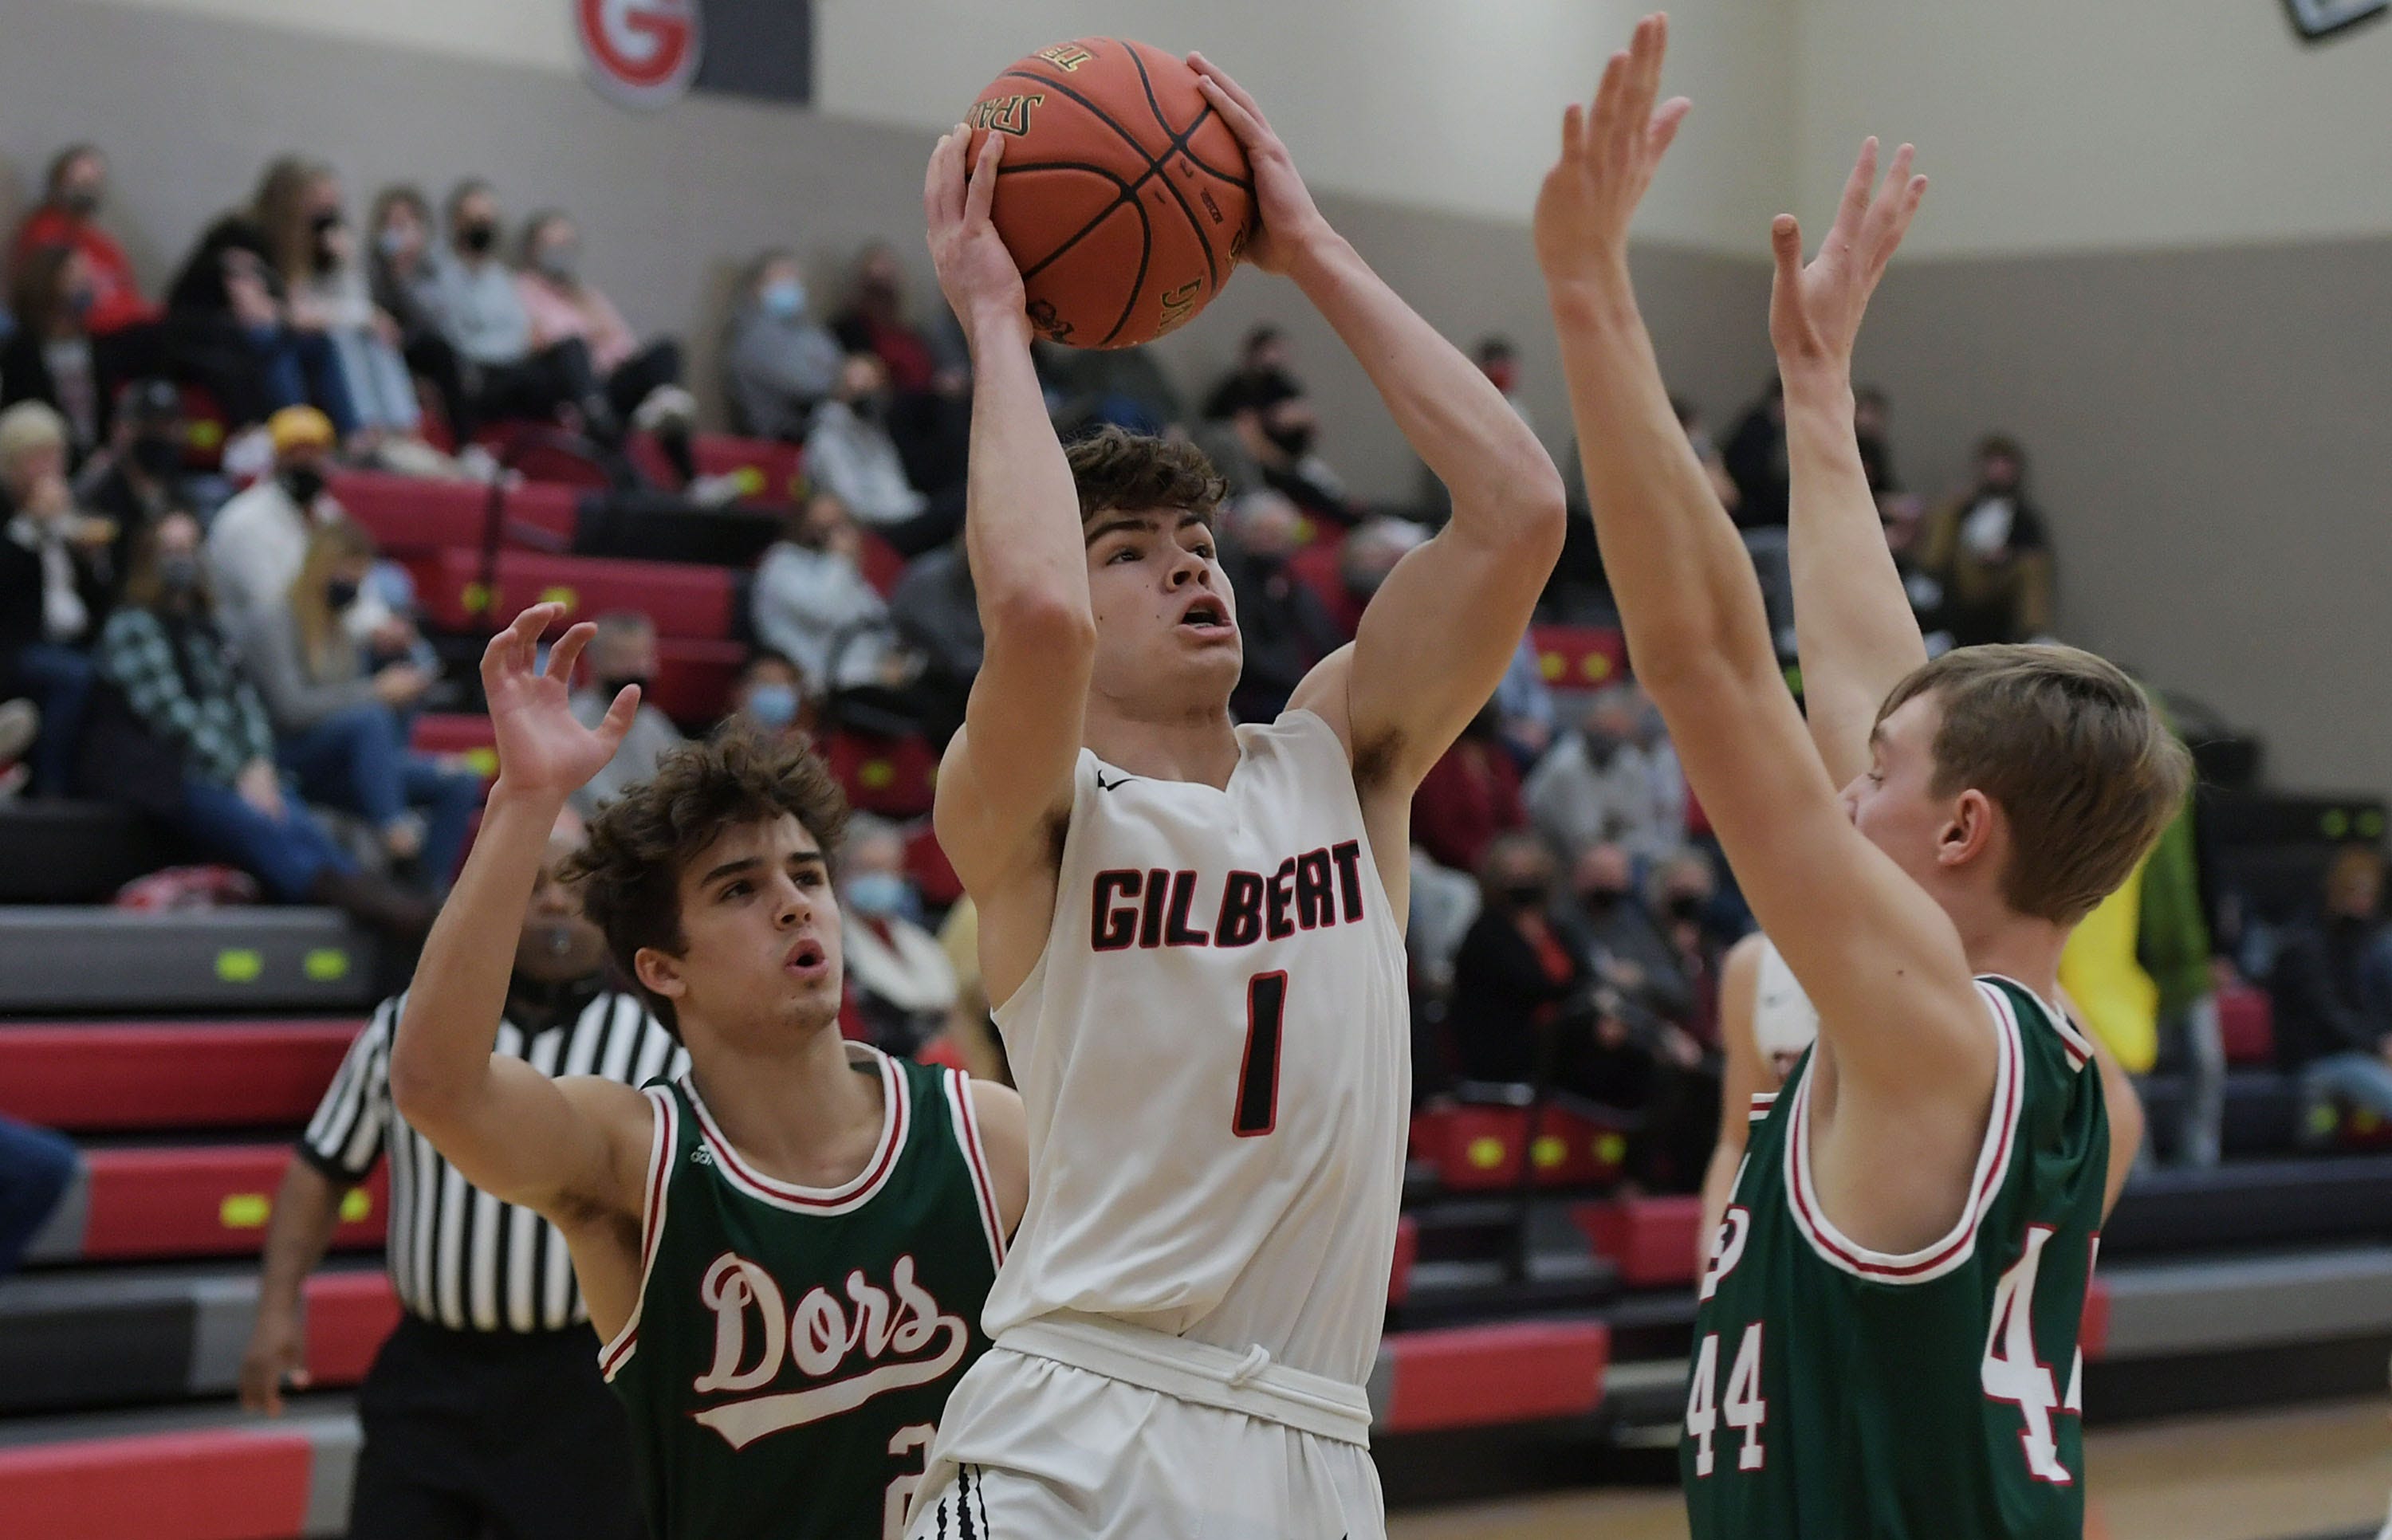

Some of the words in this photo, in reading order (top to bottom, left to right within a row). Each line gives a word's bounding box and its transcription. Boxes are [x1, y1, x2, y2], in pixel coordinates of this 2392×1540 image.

[1092, 839, 1364, 952] GILBERT
[1232, 968, 1288, 1138] 1
[692, 1250, 969, 1397] Dors
[1686, 1319, 1766, 1479] 44
